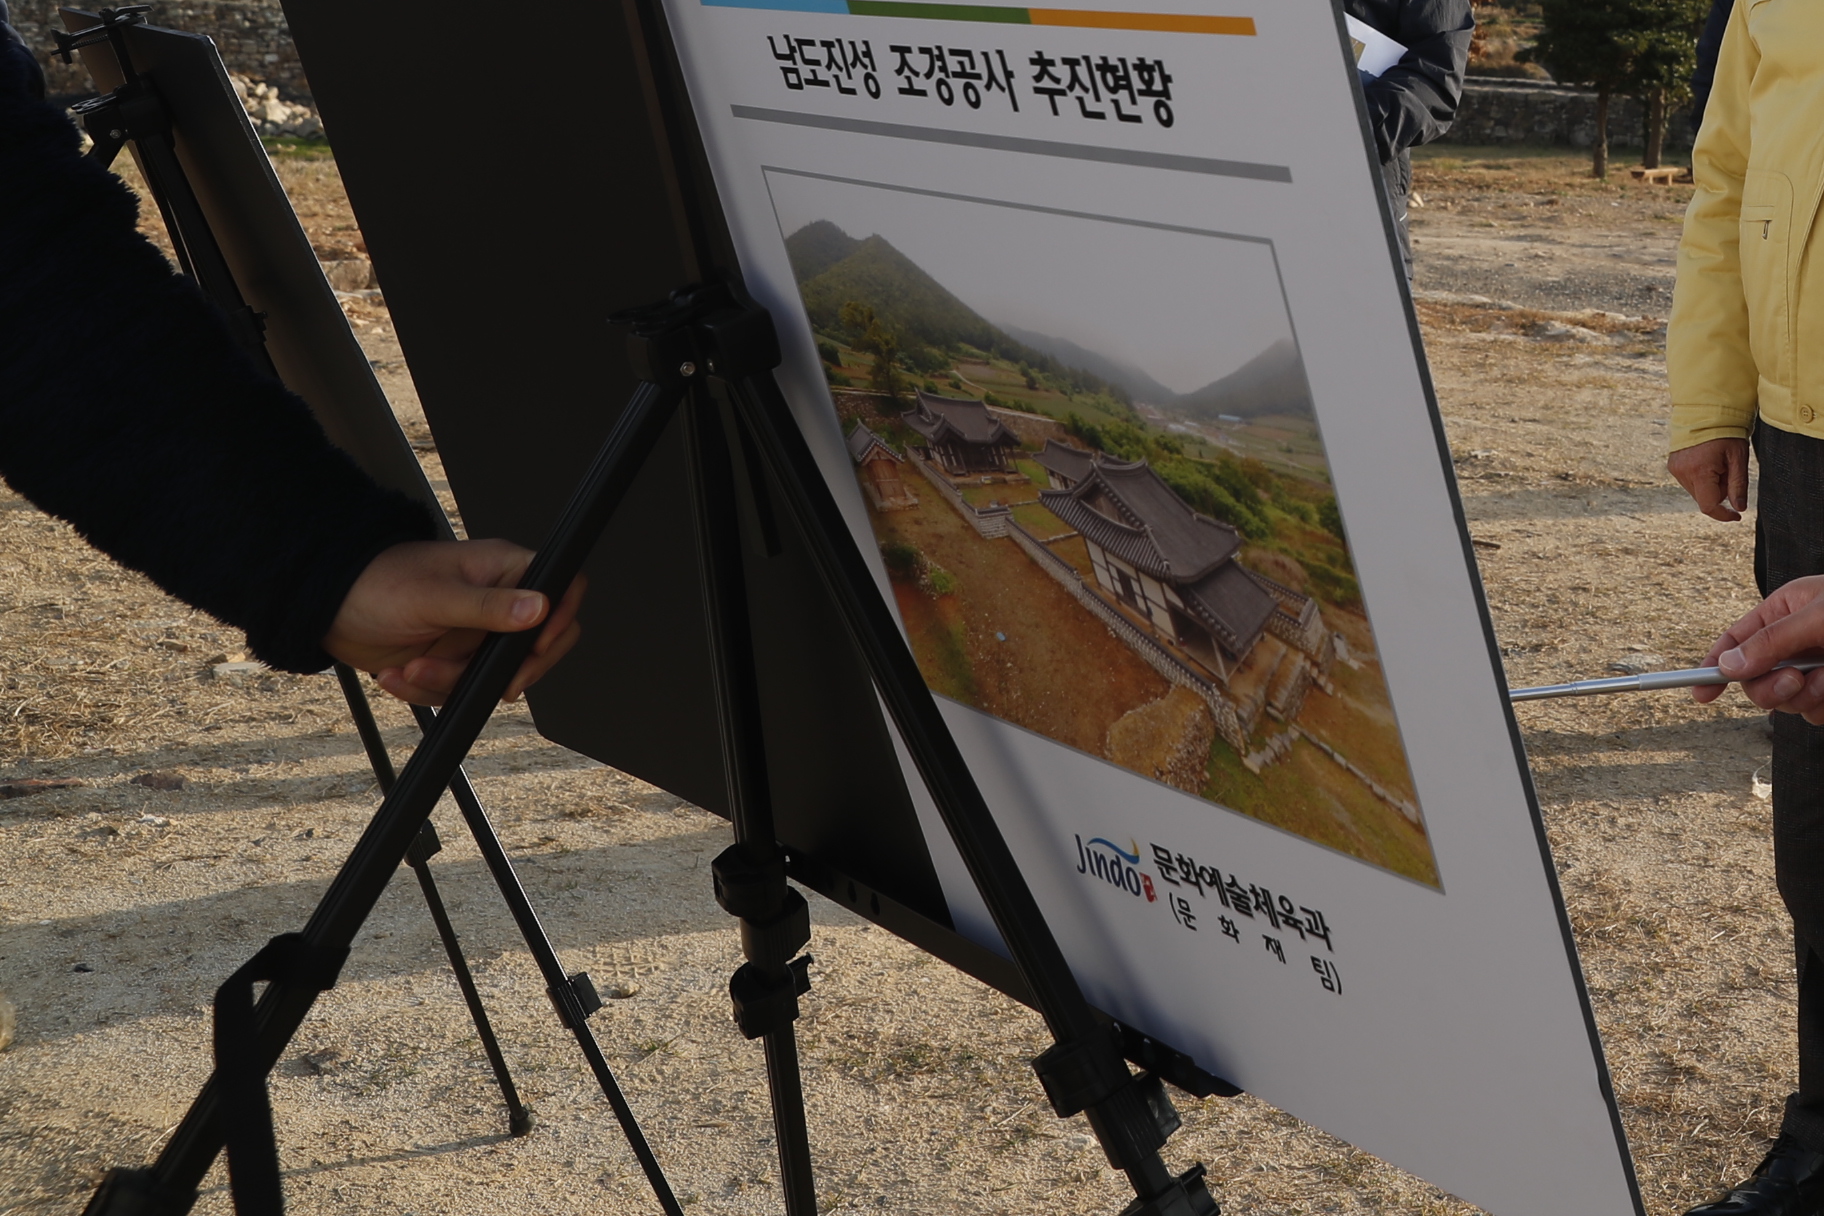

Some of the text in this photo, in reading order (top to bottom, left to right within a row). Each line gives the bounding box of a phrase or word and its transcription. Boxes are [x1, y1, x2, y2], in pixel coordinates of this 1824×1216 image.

[766, 33, 1176, 129] 남도진성 조경공사 추진현황
[1074, 833, 1142, 897] Jindo
[1149, 842, 1335, 953] 문화예술체육과
